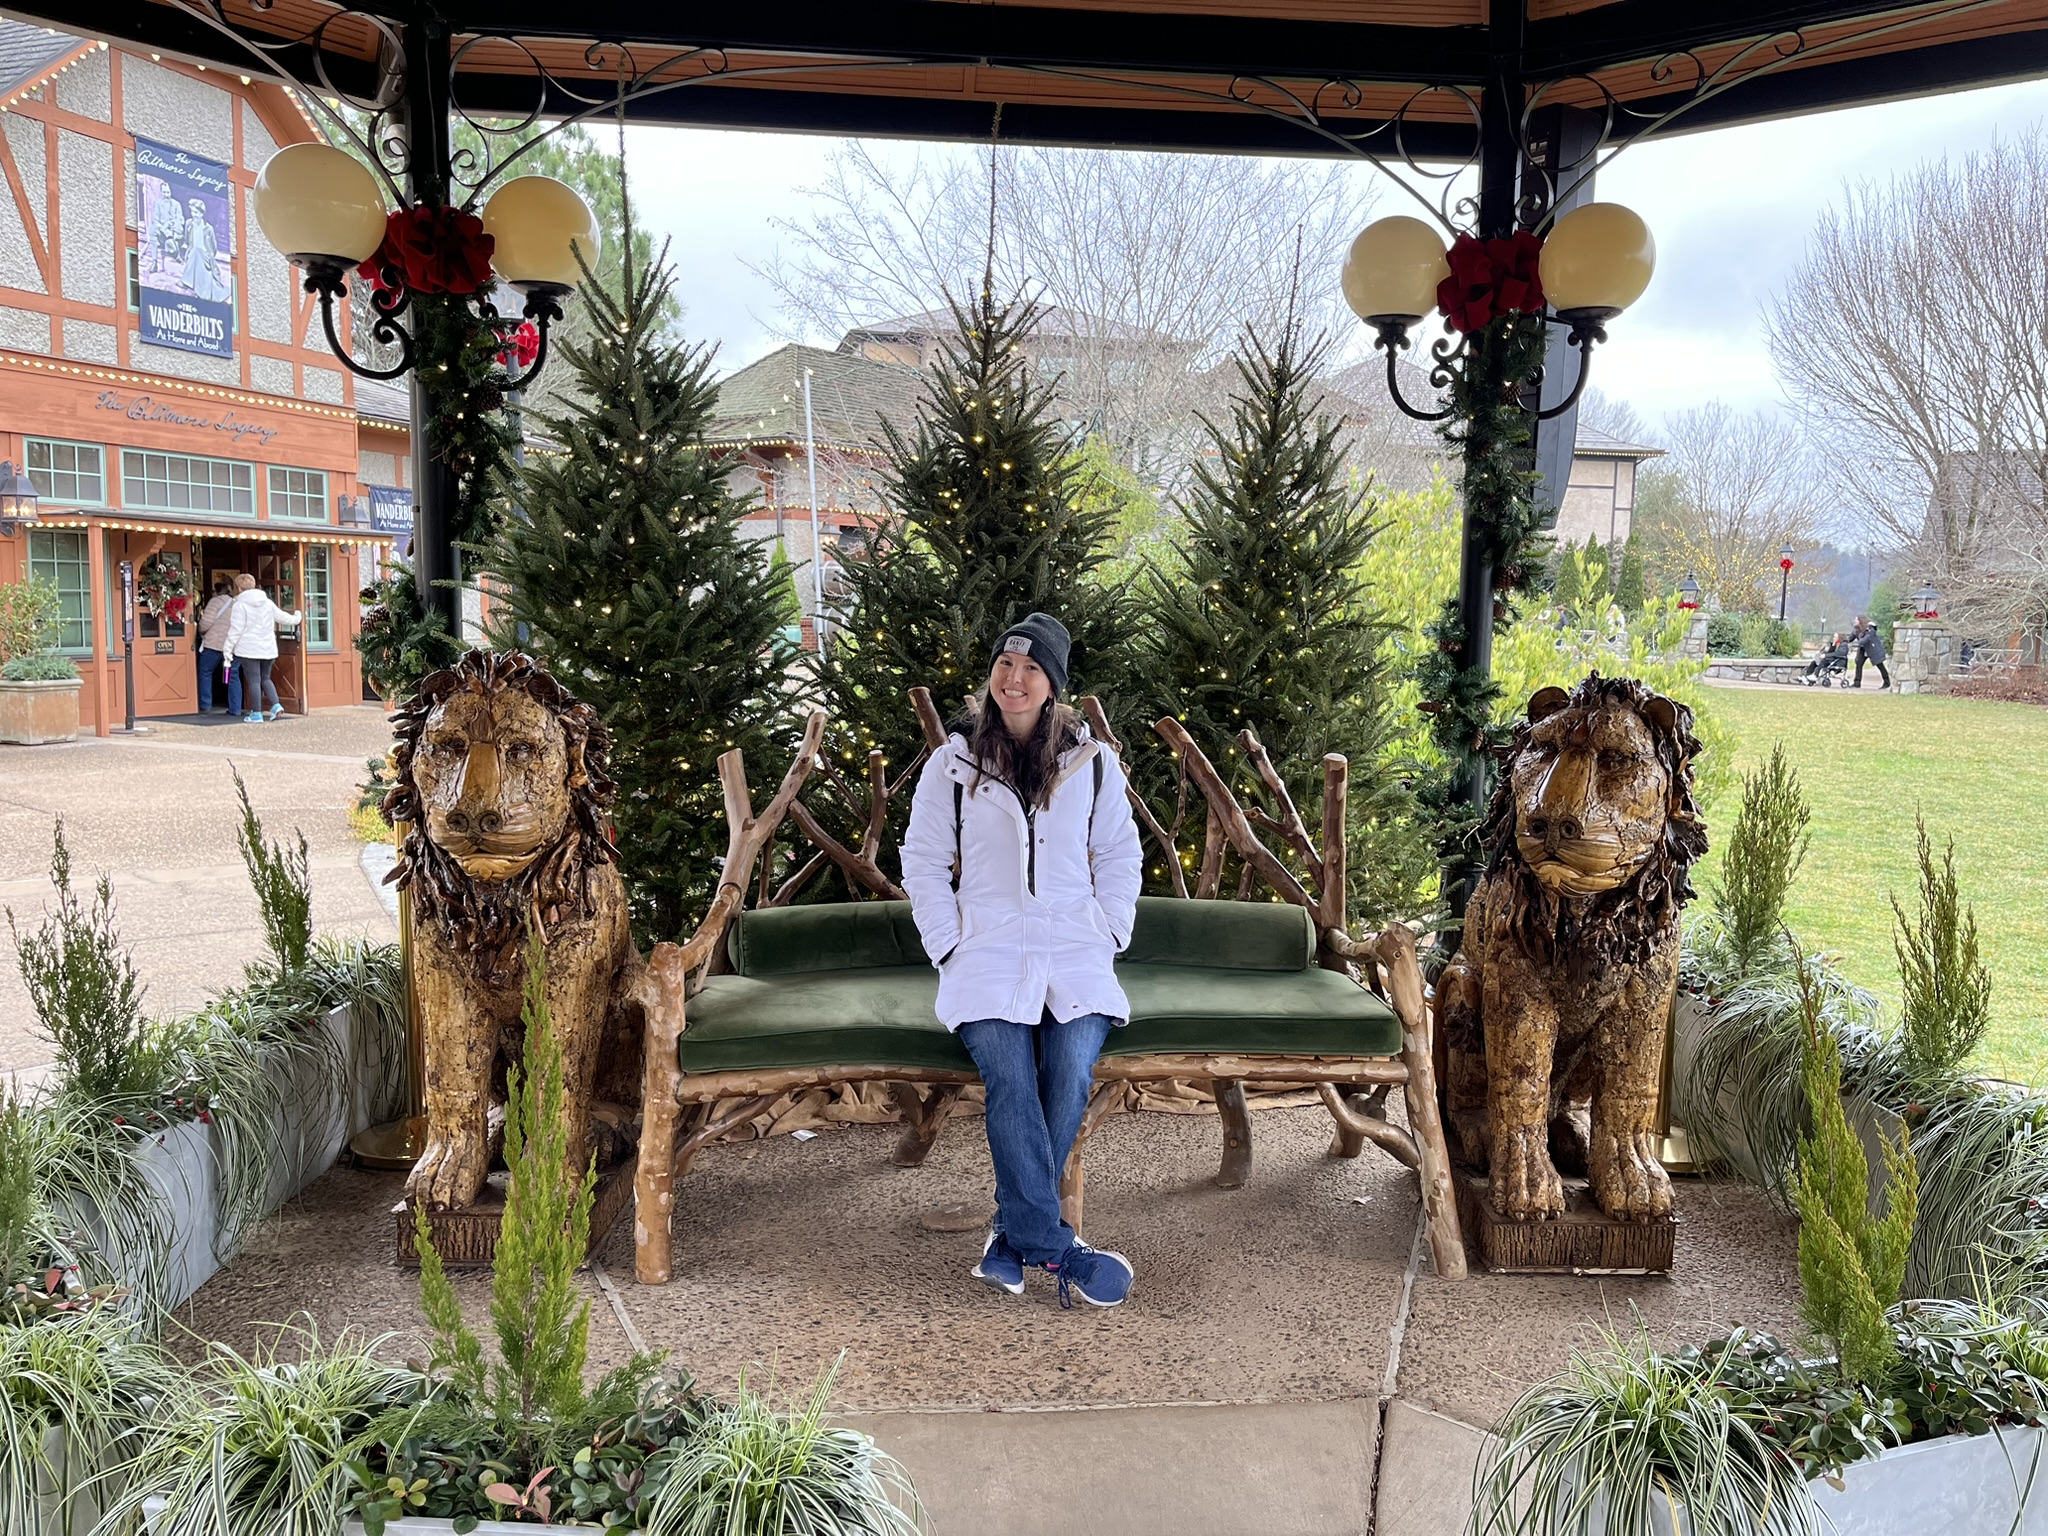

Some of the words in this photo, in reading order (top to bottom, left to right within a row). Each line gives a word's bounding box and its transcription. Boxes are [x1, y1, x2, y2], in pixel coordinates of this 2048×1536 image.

[175, 152, 190, 164] The
[138, 149, 186, 175] Biltmore
[187, 168, 226, 192] Legacy
[181, 303, 192, 312] THE
[149, 304, 224, 340] VANDERBILTS
[156, 328, 166, 340] At
[167, 331, 186, 344] Home
[186, 336, 197, 347] and
[197, 337, 219, 351] Abroad
[95, 390, 125, 411] The
[127, 396, 211, 427] Biltmore
[214, 411, 277, 445] Legacy
[375, 502, 414, 522] VANDERBI
[1009, 639, 1026, 647] BANFF
